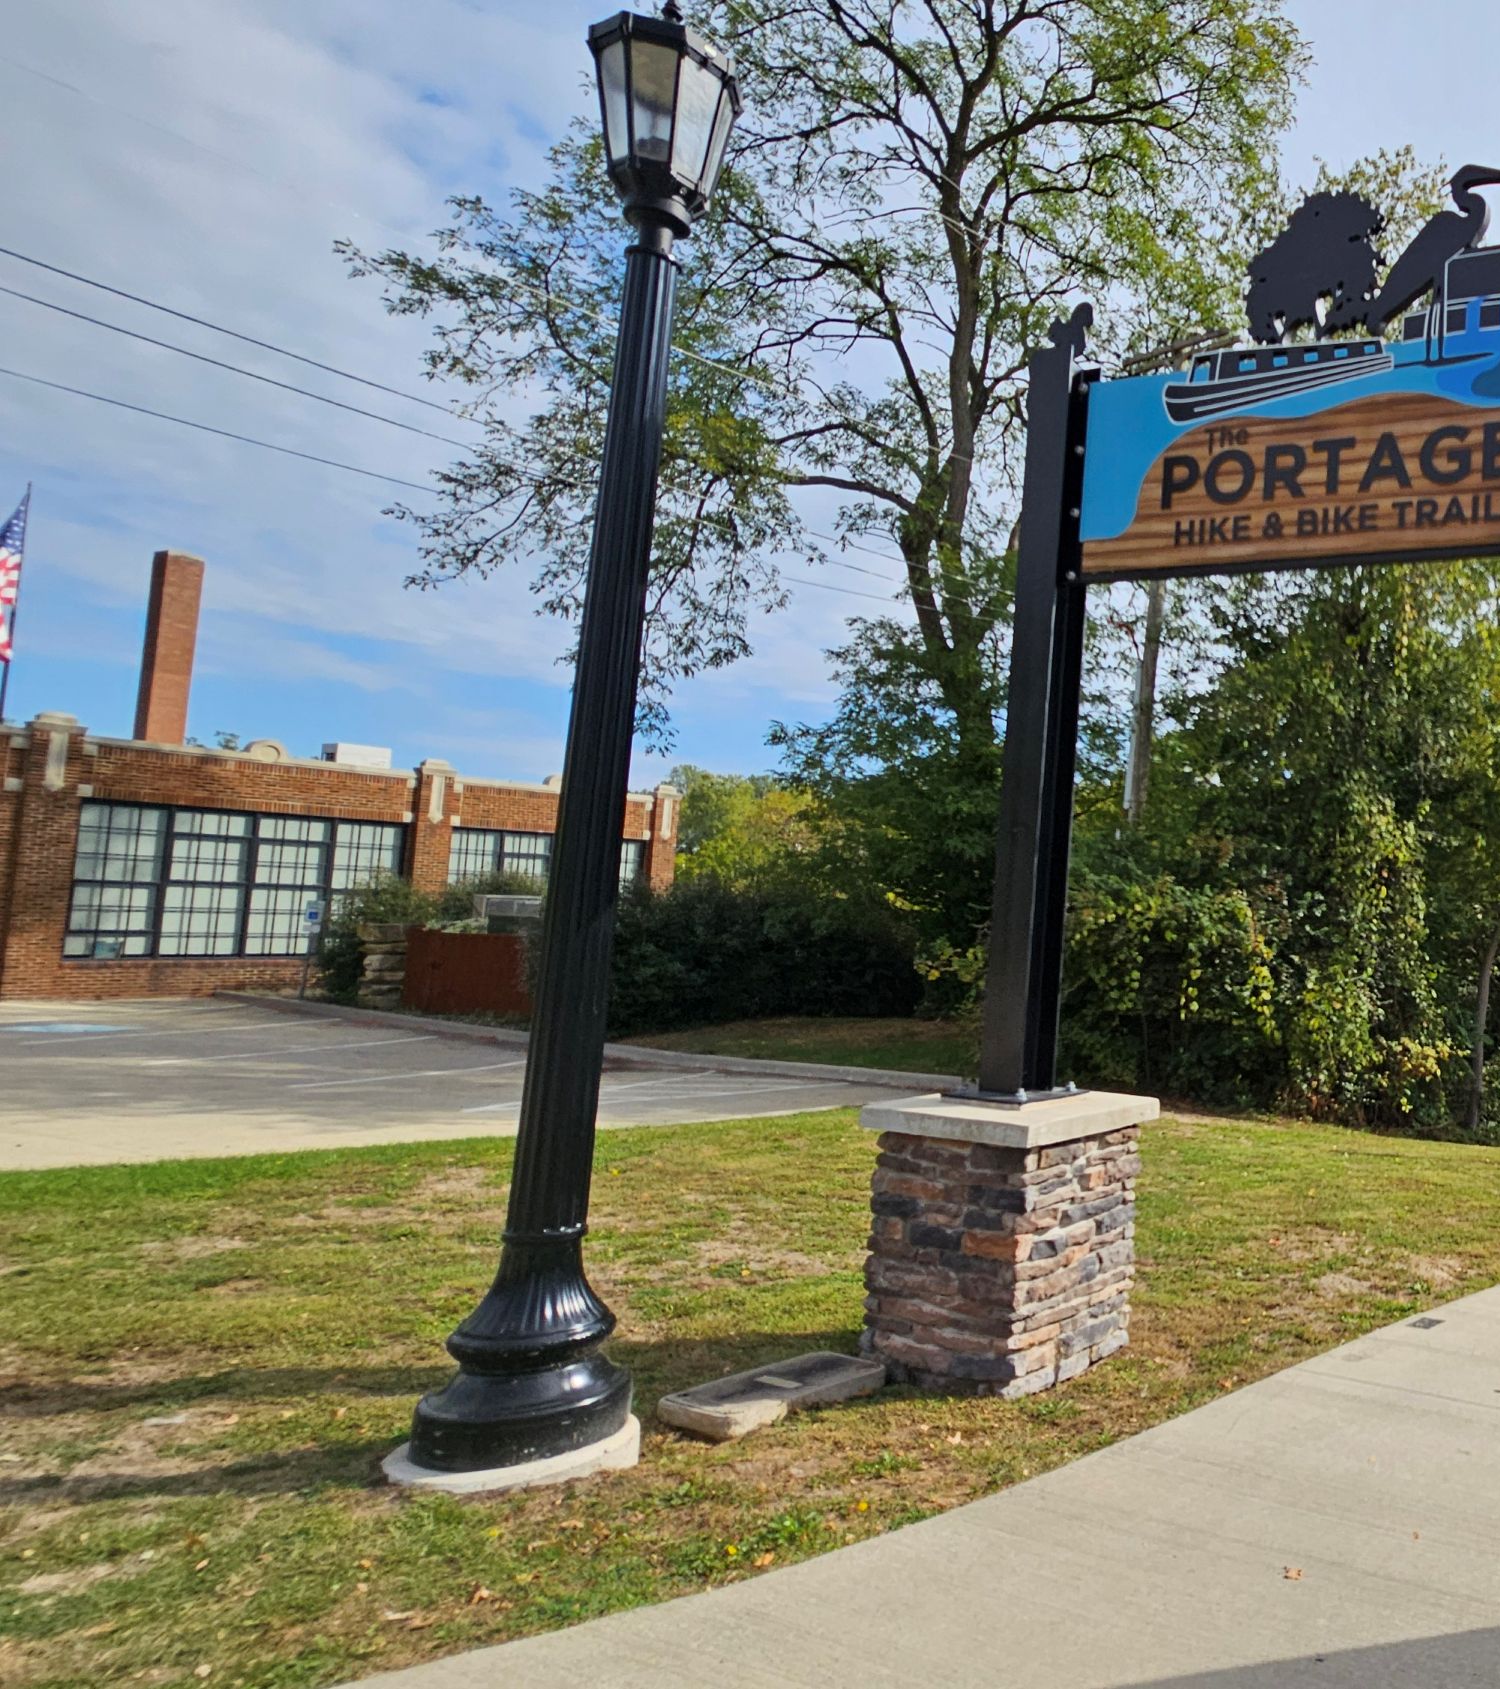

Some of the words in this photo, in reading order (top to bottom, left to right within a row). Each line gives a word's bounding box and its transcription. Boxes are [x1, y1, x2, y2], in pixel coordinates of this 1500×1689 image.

[1205, 426, 1250, 455] The
[1173, 514, 1252, 546] HIKE
[1262, 511, 1283, 539] &
[1297, 504, 1379, 537] BIKE
